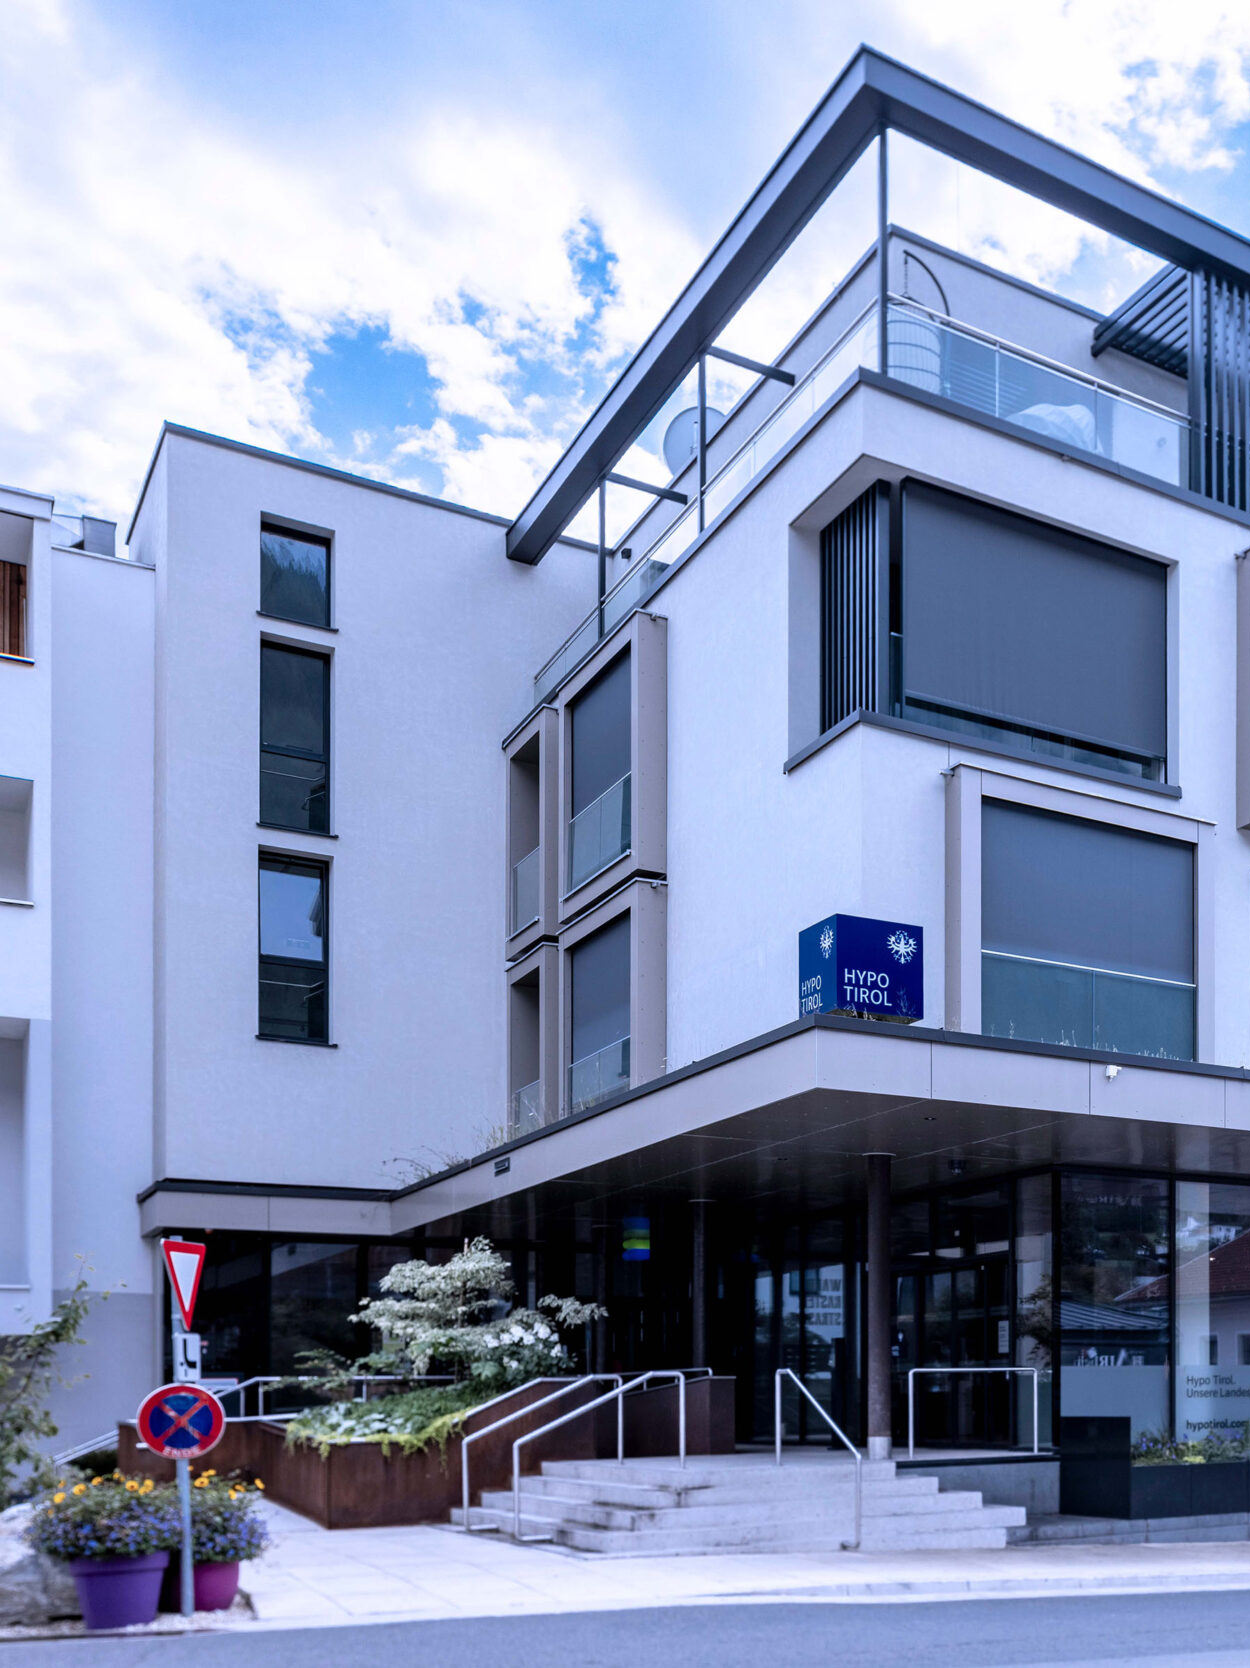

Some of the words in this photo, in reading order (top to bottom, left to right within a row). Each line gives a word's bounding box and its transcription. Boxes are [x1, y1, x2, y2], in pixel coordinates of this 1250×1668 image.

[801, 975, 821, 997] HYPO
[844, 968, 889, 988] HYPO
[801, 992, 823, 1013] TIROL
[843, 985, 892, 1007] TIROL
[1186, 1375, 1211, 1388] Hypo
[1186, 1388, 1218, 1398] Unsere
